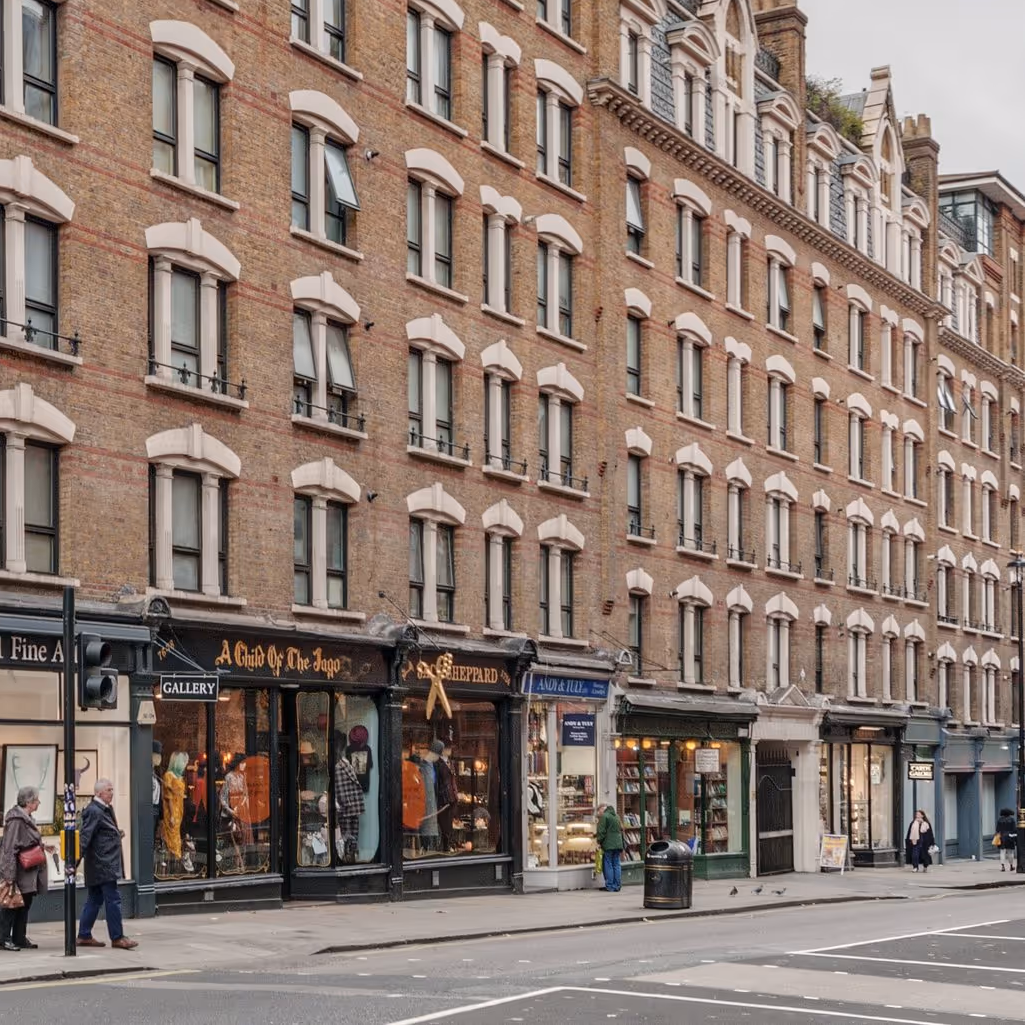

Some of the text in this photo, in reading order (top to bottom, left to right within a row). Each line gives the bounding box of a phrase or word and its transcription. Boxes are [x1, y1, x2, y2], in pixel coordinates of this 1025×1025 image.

[10, 635, 47, 662] Fine
[215, 639, 340, 679] A Child Of The Jago
[162, 681, 216, 695] GALLERY
[537, 677, 558, 692] ANDY
[558, 679, 565, 692] &
[566, 679, 584, 694] TULY
